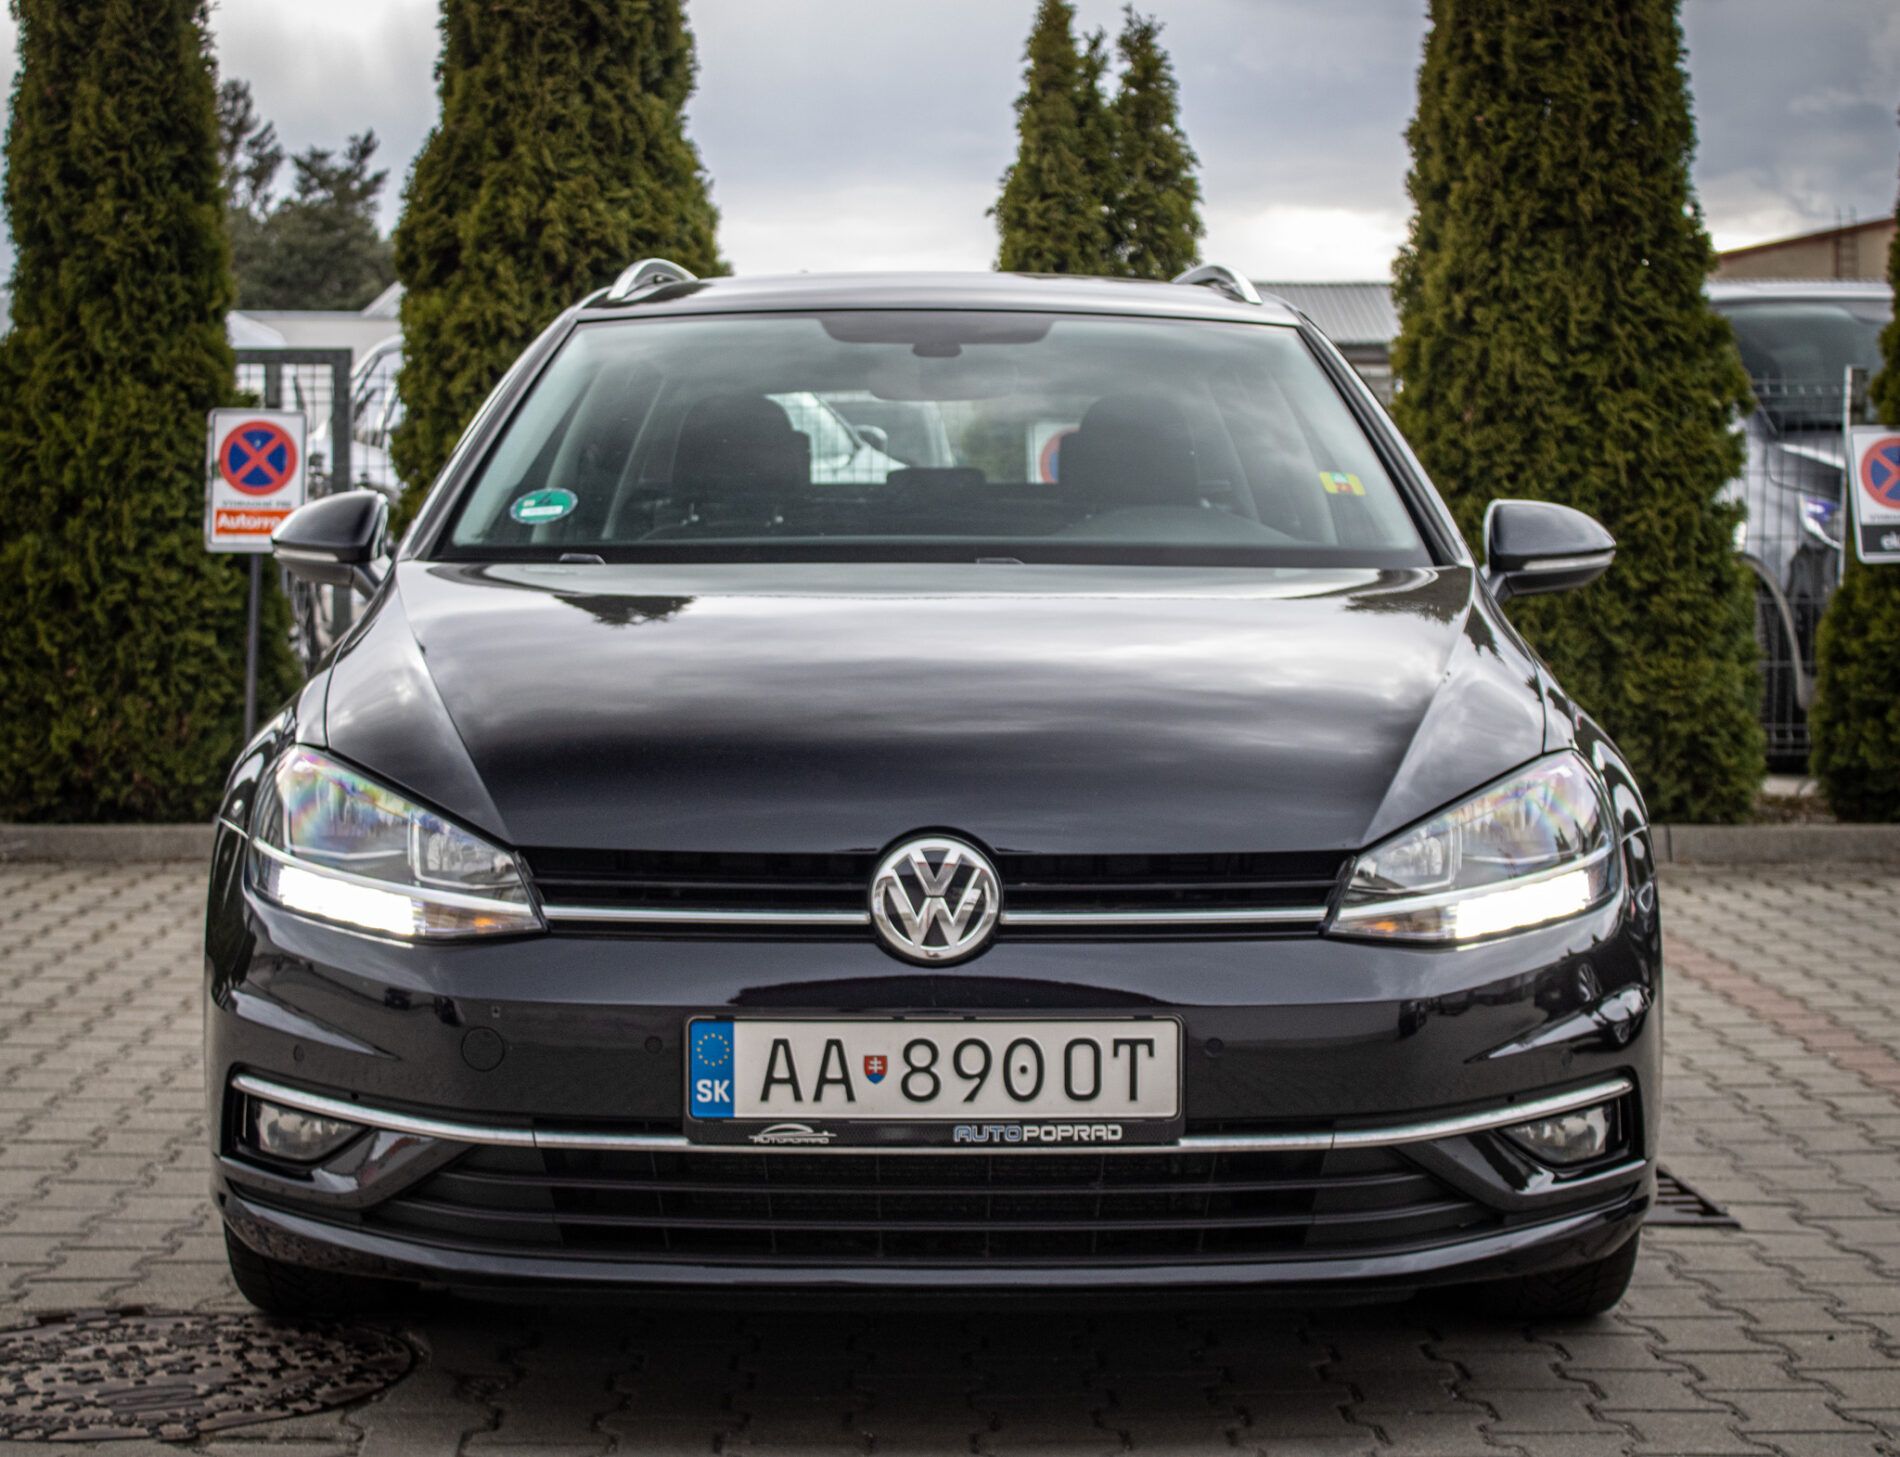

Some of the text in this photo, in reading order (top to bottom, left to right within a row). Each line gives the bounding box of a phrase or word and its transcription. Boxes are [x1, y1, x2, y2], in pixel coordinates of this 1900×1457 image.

[760, 1038, 856, 1102] AA
[696, 1079, 730, 1102] SK
[953, 1124, 1122, 1142] AUTOPOPRAD
